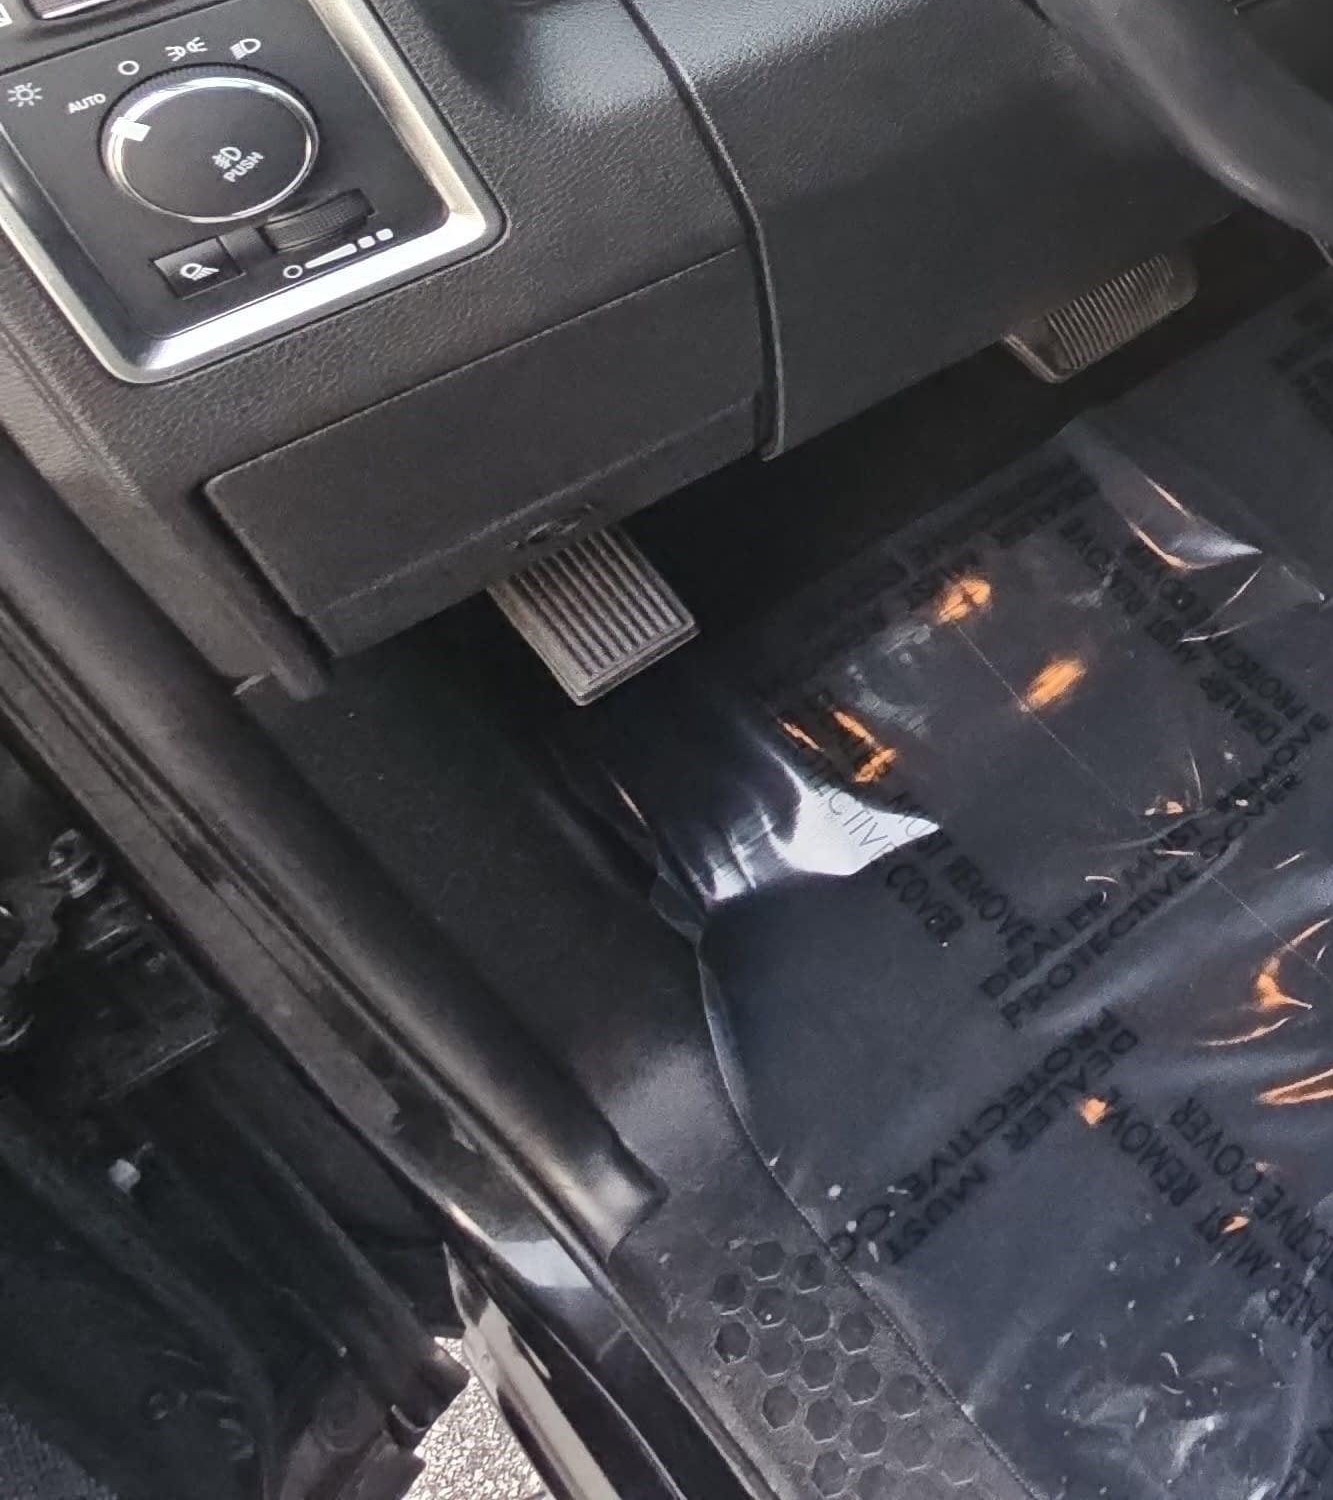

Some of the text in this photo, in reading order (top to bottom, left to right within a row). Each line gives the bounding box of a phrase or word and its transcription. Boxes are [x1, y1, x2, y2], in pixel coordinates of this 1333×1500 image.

[67, 92, 107, 115] AUTO
[222, 151, 265, 183] PUSH
[1168, 1097, 1265, 1198] COVER
